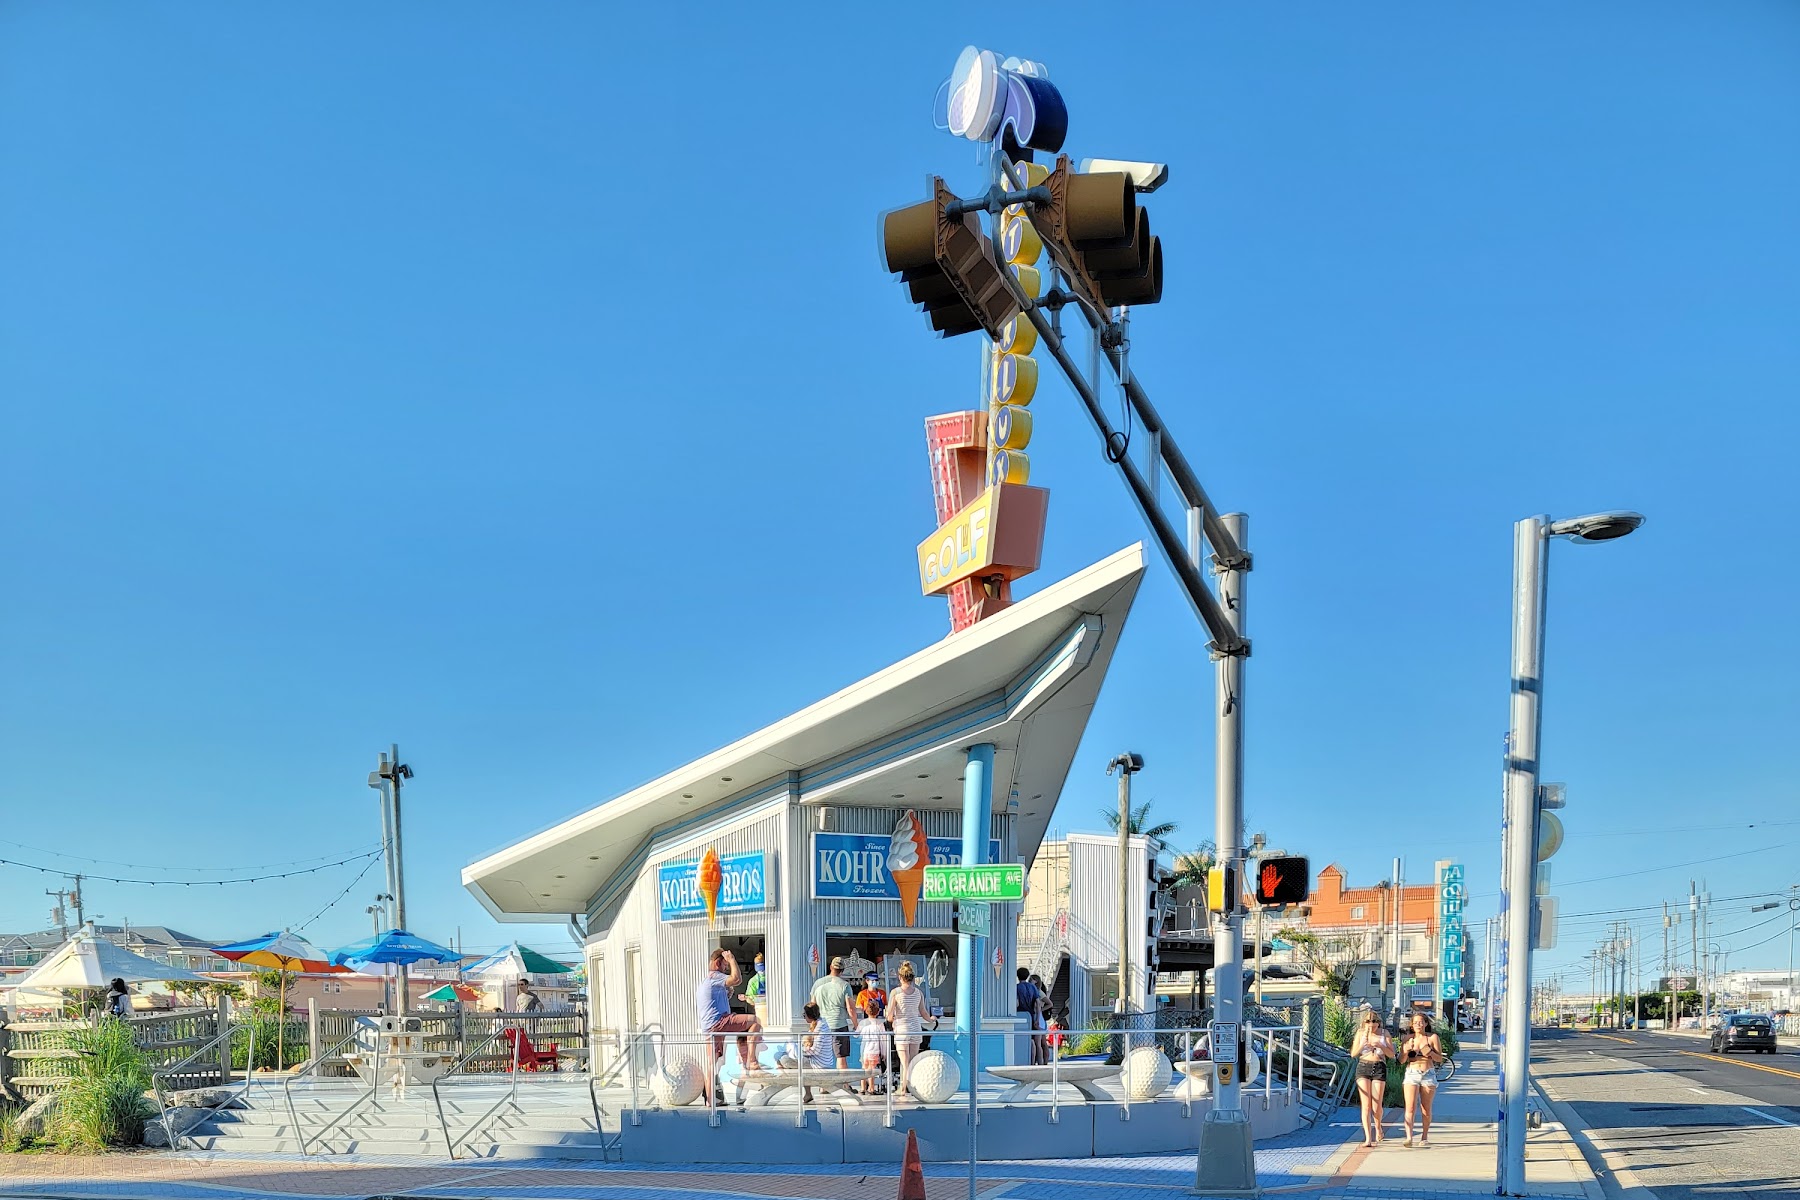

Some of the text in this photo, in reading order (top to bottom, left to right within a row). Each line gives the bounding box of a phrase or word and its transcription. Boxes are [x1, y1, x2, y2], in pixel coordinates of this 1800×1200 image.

[923, 506, 987, 585] GOLF
[818, 849, 886, 884] KOHR
[661, 877, 701, 909] KOHR
[853, 884, 886, 894] Frozen
[925, 871, 1022, 896] RIO GRANDE AVE
[959, 905, 984, 928] OCEAN
[1443, 866, 1463, 997] AQUARIUS
